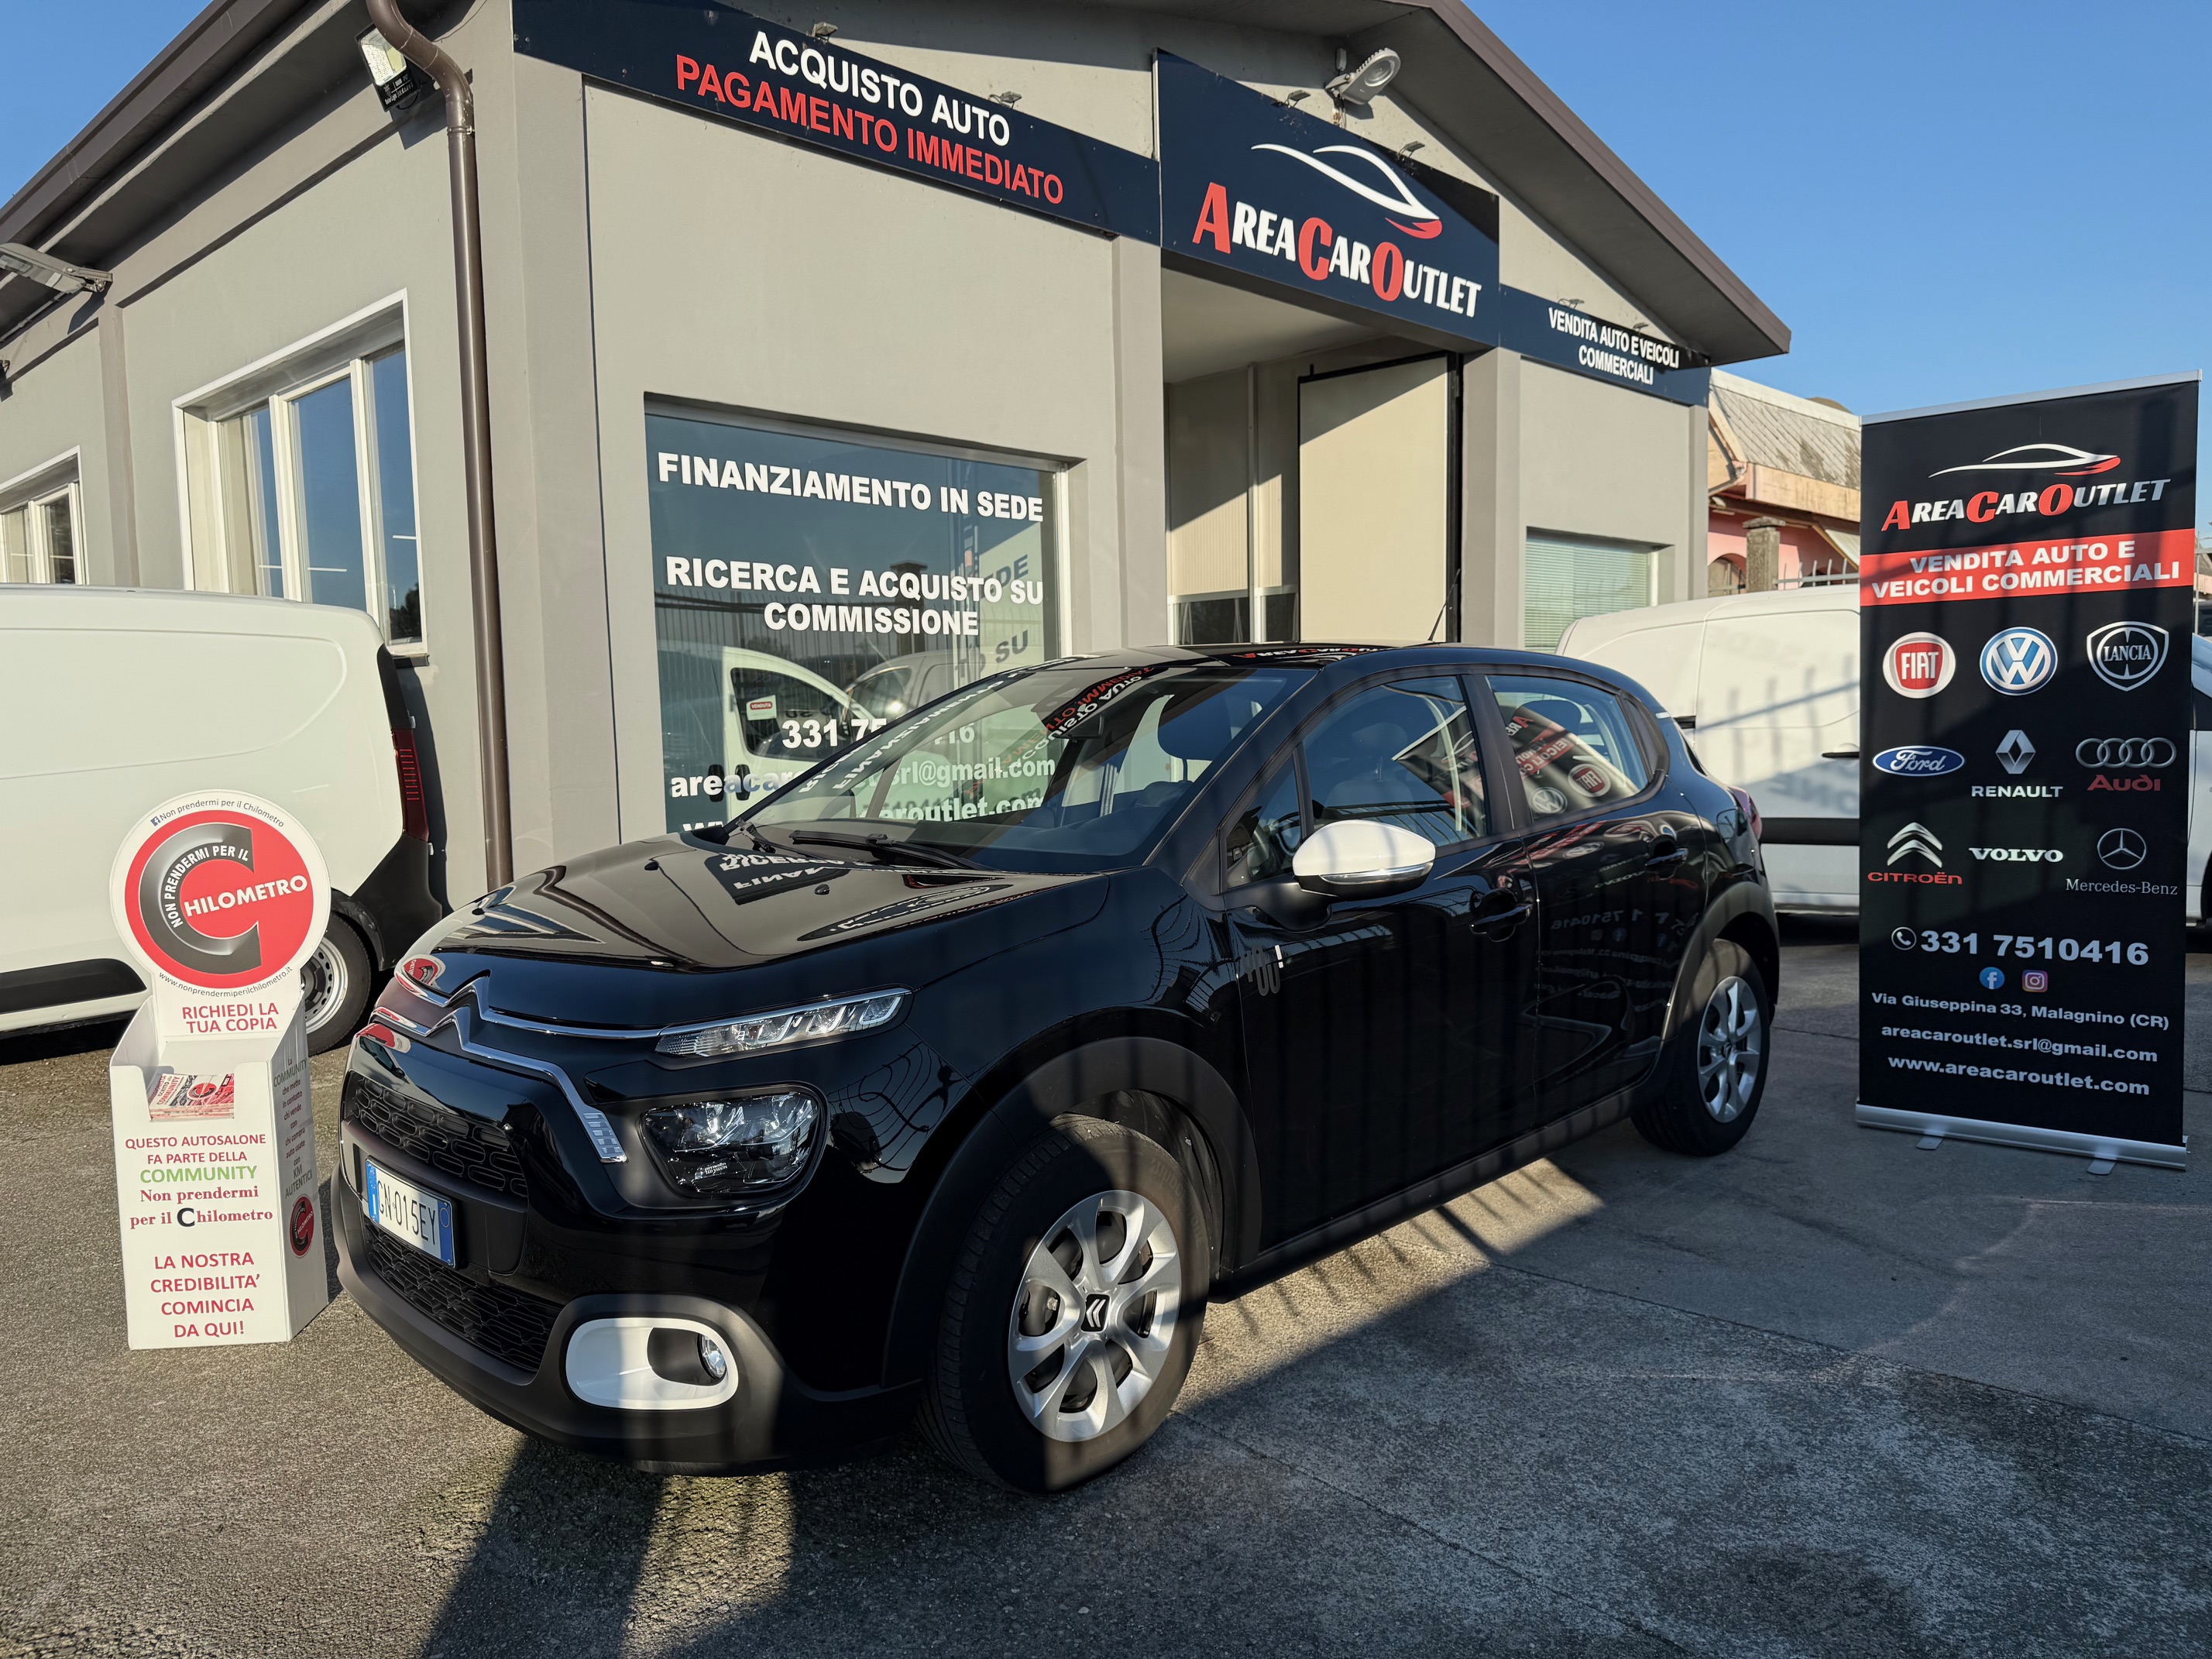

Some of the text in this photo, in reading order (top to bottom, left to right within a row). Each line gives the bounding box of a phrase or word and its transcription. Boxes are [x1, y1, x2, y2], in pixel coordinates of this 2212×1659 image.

[749, 30, 1011, 147] ACQUISTO AUTO
[675, 53, 1064, 204] PAGAMENTO IMMEDIATO
[1548, 307, 1679, 369] VENDITA AUTO E VEICOLI
[1577, 345, 1654, 386] COMMERCIALI
[658, 452, 1043, 522] FINANZIAMENTO IN SEDE
[1910, 541, 2135, 573] VENDITA AUTO E
[665, 556, 1043, 605] RICERCA E ACQUISTO SU
[1872, 562, 2179, 599] VEICOLI COMMERCIALI
[764, 603, 979, 636] COMMISSIONE
[1901, 651, 1938, 680] FIAT
[2104, 646, 2152, 661] LANCIA
[781, 719, 838, 748] 331
[1891, 749, 1946, 771] Ford
[1971, 785, 2063, 798] RENAULT
[2087, 775, 2160, 792] Audi
[160, 810, 177, 821] Non
[177, 799, 218, 814] prendermi
[243, 802, 284, 827] Chilometro
[1969, 848, 2063, 863] VOLVO
[164, 845, 249, 928] NON PRENDERMI PER IL
[2066, 878, 2178, 895] Mercedes-Benz
[1921, 930, 2149, 965] 331 7510416
[159, 966, 293, 998] www.nonprendermiperilchilometro.it
[182, 1003, 279, 1018] RICHIEDI LA
[1872, 992, 2169, 1030] Via Giuseppina 33, Malagnino (CR)
[186, 1018, 277, 1033] TUA COPIA
[1882, 1024, 2158, 1062] areacaroutlet.srl@gmail.com
[273, 1058, 307, 1087] COMMUNITY
[1888, 1057, 2149, 1095] www.areacaroutlet.com
[125, 1135, 266, 1149] QUESTO AUTOSALONE
[147, 1152, 247, 1164] FA PARTE DELLA
[294, 1164, 302, 1179] KM
[140, 1166, 257, 1183] COMMUNITY
[285, 1170, 312, 1199] AUTENTICI
[140, 1186, 259, 1204] Non prendermi
[129, 1207, 273, 1229] per il Chilometro
[155, 1252, 254, 1269] LA NOSTRA
[161, 1298, 254, 1315] COMINCIA
[174, 1321, 244, 1338] DA QUI!
